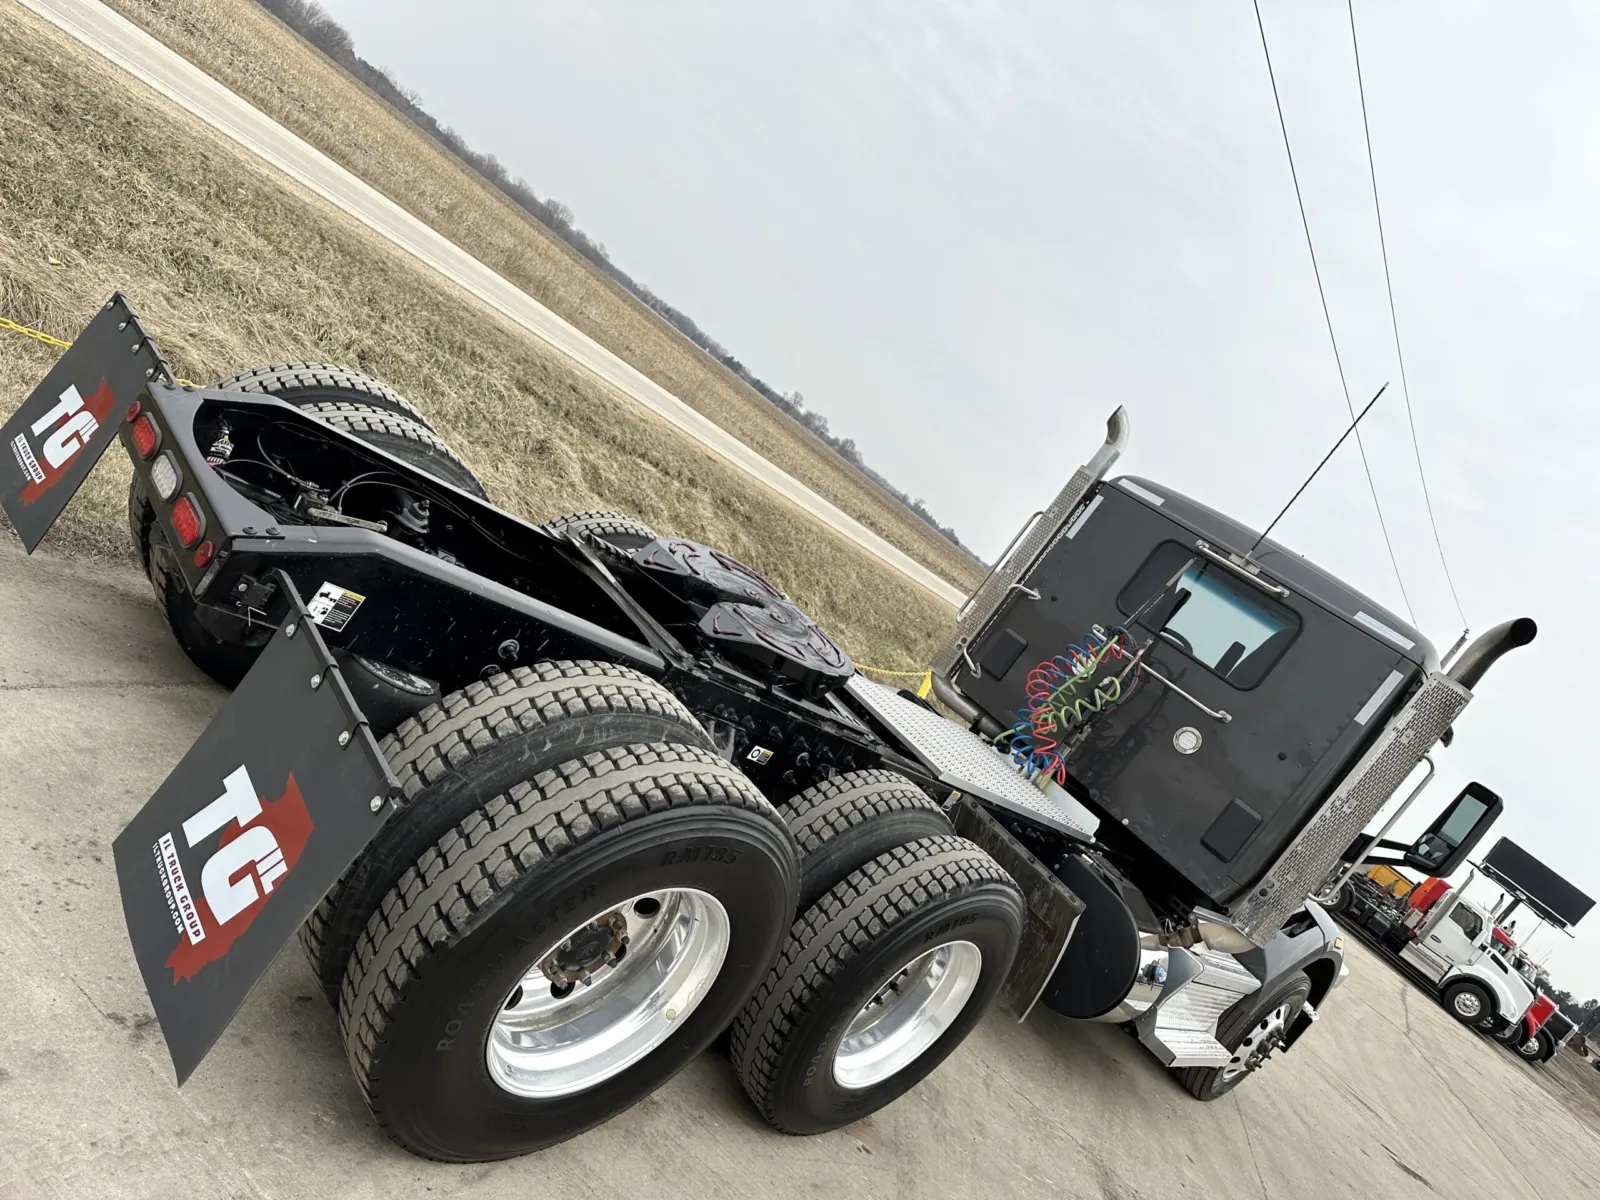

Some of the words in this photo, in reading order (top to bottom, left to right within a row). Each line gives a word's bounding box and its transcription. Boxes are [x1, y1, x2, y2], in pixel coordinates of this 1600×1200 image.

[20, 442, 32, 460] TRUCK
[28, 460, 43, 480] GROUP
[163, 838, 172, 851] IL
[660, 846, 741, 867] RM185
[152, 842, 184, 934] ILTRUCKGROUP.COM
[167, 852, 184, 892] TRUCK
[180, 895, 201, 938] GROUP
[924, 913, 979, 943] RM185
